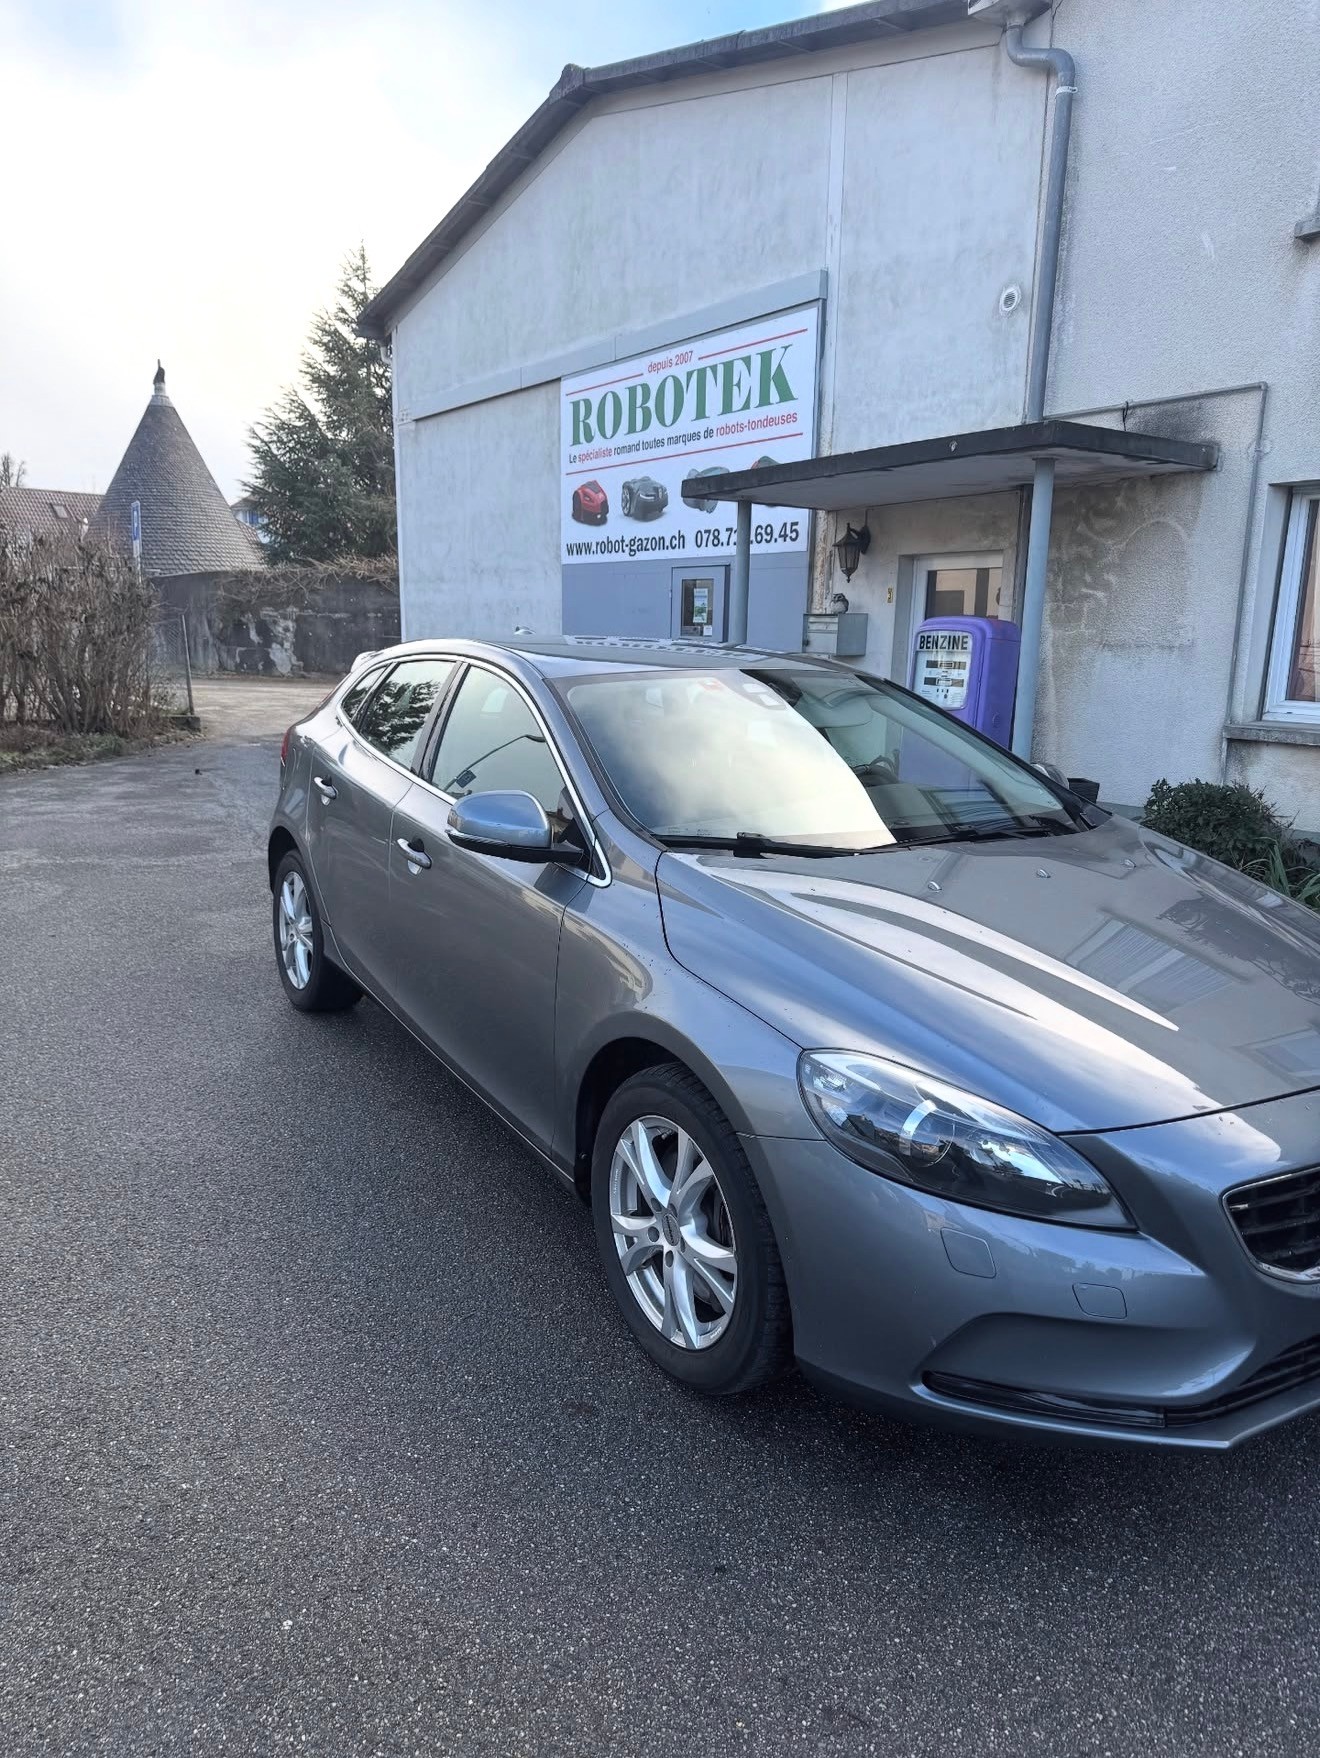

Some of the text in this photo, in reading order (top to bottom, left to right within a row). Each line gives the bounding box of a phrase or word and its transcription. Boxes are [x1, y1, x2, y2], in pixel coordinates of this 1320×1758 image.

[647, 350, 694, 374] depuis 2007
[569, 344, 799, 446] ROBOTEK
[568, 412, 798, 464] Le spécialiste romand toutes marques de robots-tondeuses
[566, 521, 799, 557] www.robot-gazon.ch 078.7.69.45
[919, 634, 969, 651] BENZINE
